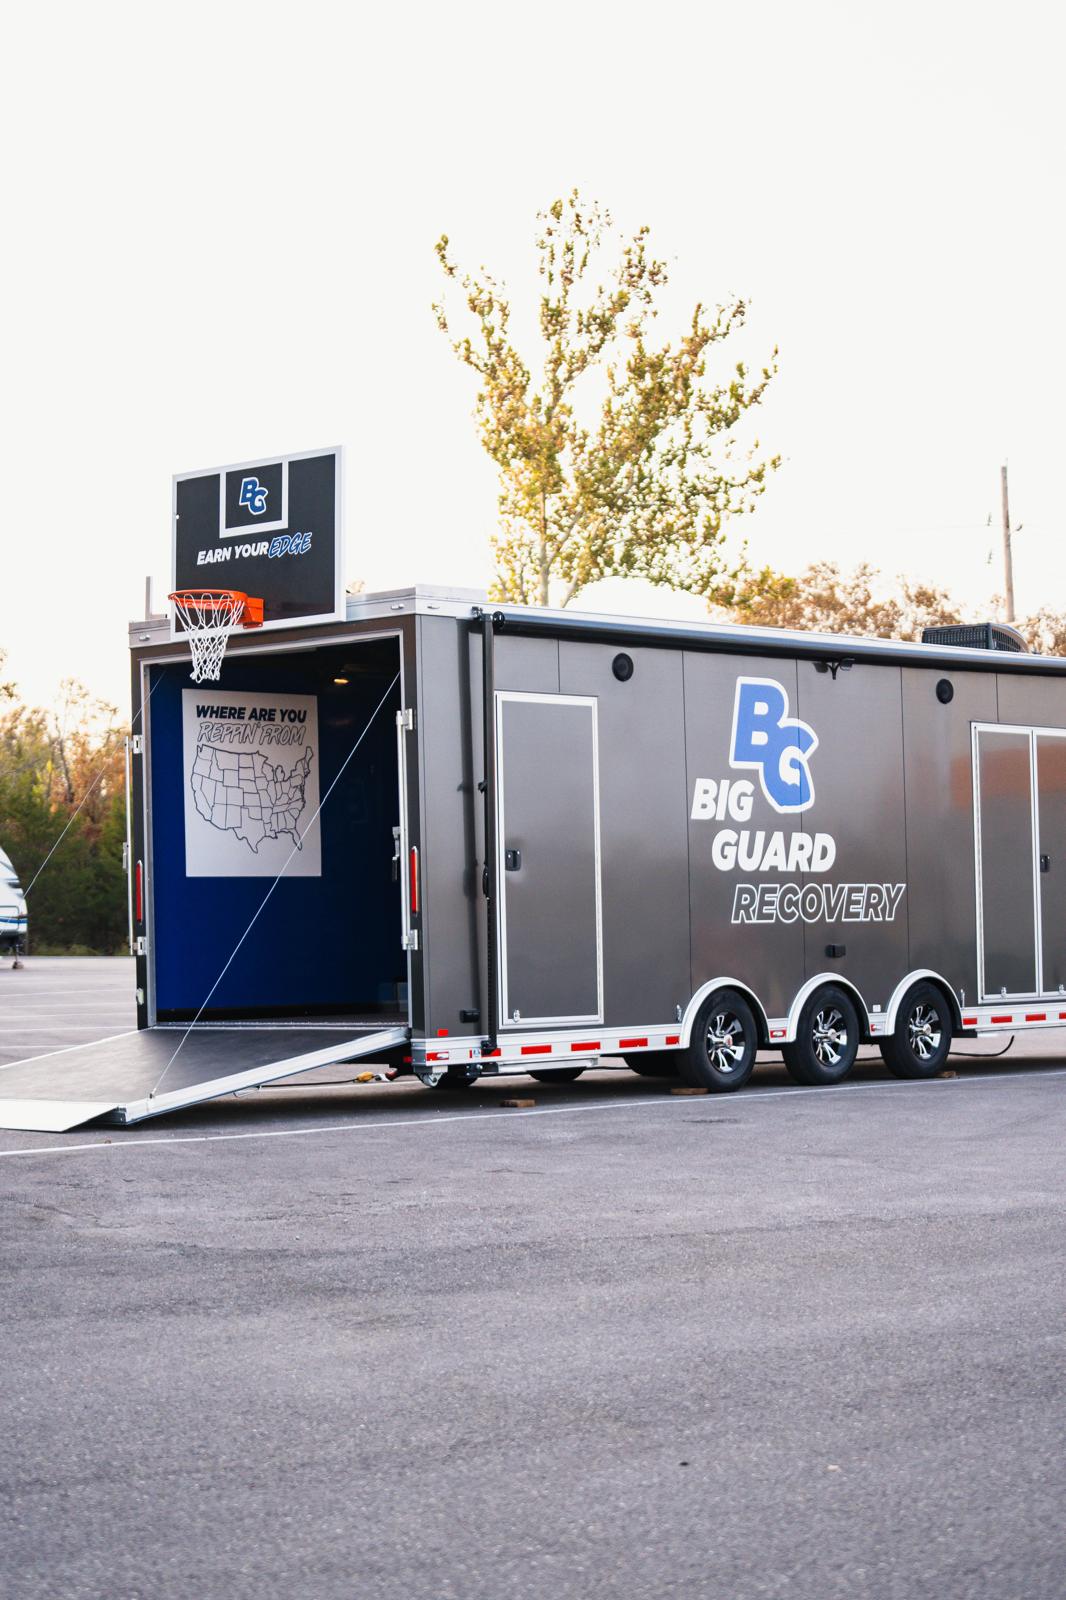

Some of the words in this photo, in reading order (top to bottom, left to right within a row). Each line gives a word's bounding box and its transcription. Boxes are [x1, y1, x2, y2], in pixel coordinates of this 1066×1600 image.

[239, 476, 268, 515] BG
[197, 547, 231, 565] EARN
[234, 541, 269, 560] YOUR
[268, 532, 312, 558] EDGE
[196, 705, 246, 720] WHERE
[248, 708, 276, 722] ARE
[279, 709, 307, 723] YOU
[197, 721, 261, 744] REPPIN'
[259, 724, 306, 745] FROM
[729, 676, 819, 814] BG
[691, 778, 755, 822] BIG
[711, 829, 836, 872] GUARD
[731, 883, 906, 924] RECOVERY
